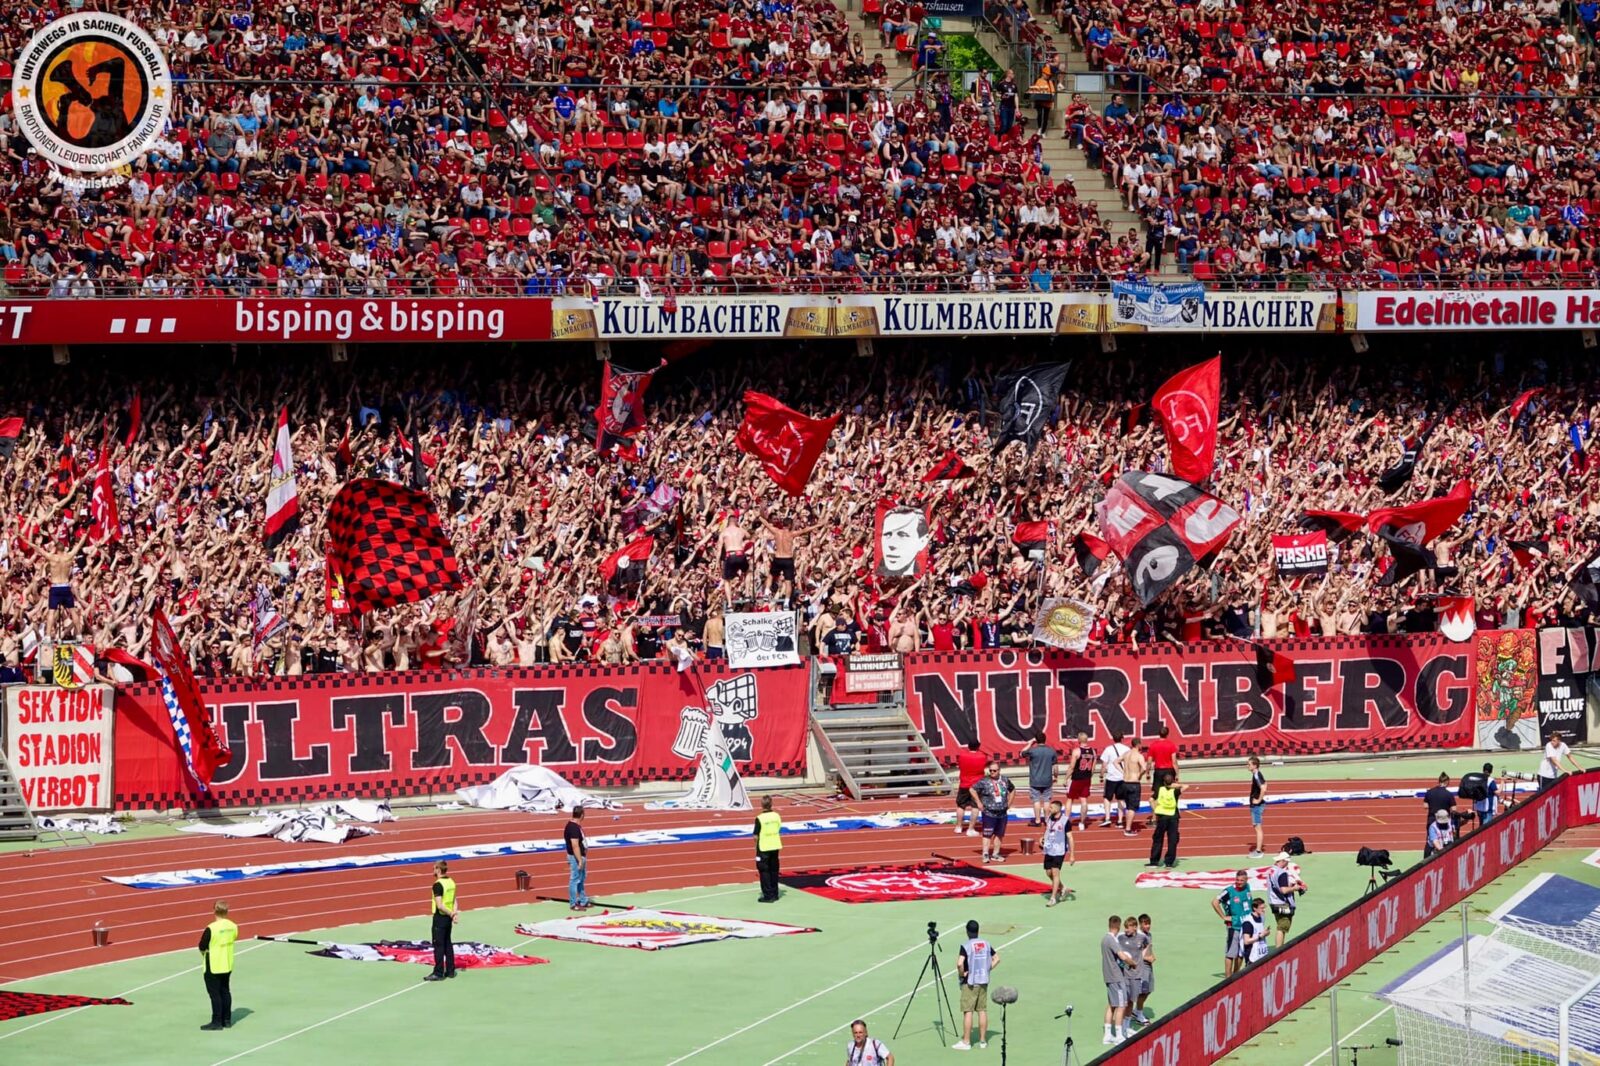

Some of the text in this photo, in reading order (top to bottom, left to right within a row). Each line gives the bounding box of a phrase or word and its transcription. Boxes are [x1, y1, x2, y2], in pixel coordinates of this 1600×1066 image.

[235, 301, 505, 340] bisping & bisping
[602, 300, 781, 334] KULMBACHER
[882, 298, 1054, 331] KULMBACHER
[1203, 300, 1315, 328] MBACHER
[1376, 296, 1557, 326] Edelmetalle
[1275, 543, 1327, 563] FIASKO
[742, 617, 773, 626] Schalke
[18, 689, 103, 724] SEKTION
[913, 649, 1471, 750] NÜRNBERG
[1540, 700, 1562, 713] WILL
[1551, 686, 1571, 699] YOU
[18, 732, 101, 767] STADION
[205, 687, 639, 786] ULTRAS
[19, 773, 100, 808] VERBOT
[1537, 795, 1560, 841] WOLF
[1500, 818, 1525, 865] WOLF
[1457, 842, 1485, 892] WOLF
[1414, 868, 1443, 920] WOLF
[1367, 896, 1399, 950] WOLF
[1317, 926, 1351, 983] WOLF
[1262, 958, 1299, 1018] WOLF
[1203, 992, 1243, 1056] WOLF
